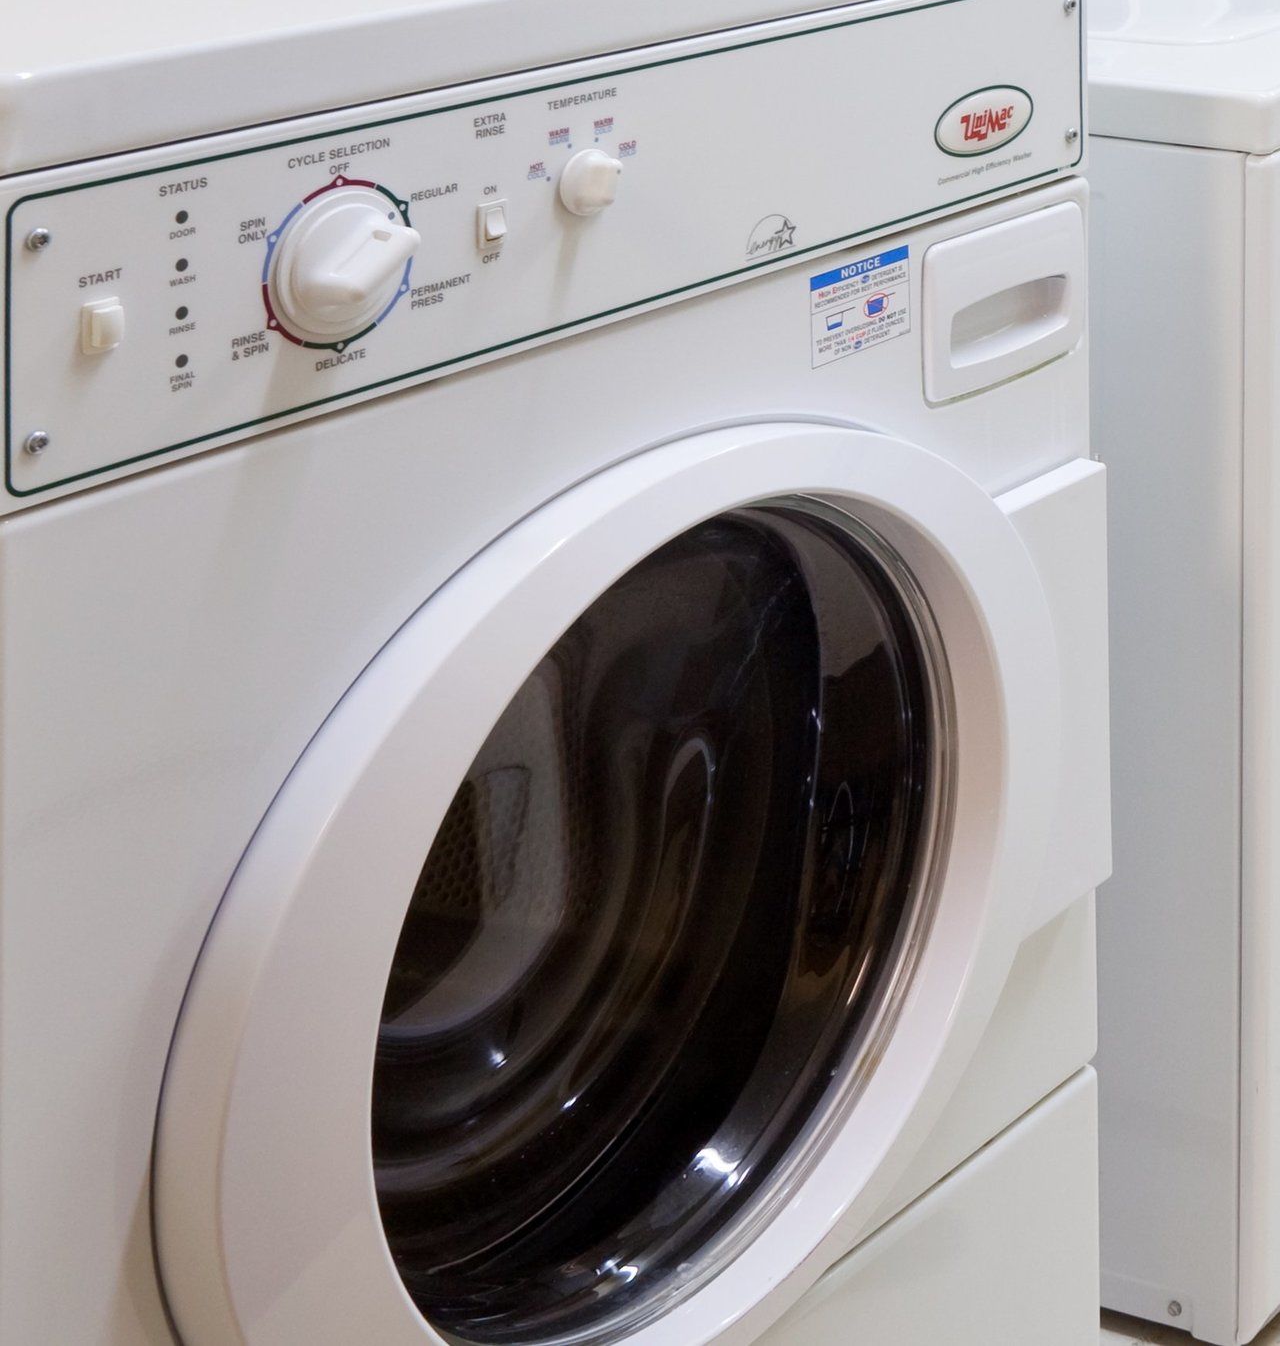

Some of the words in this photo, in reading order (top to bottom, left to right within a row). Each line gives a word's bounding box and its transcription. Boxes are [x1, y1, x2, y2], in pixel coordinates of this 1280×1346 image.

[547, 87, 617, 110] TEMPERATURE
[473, 112, 506, 128] EXTRA
[961, 105, 1014, 141] UniMac
[476, 124, 505, 139] RINSE
[288, 152, 325, 169] CYCLE
[329, 138, 391, 159] SELECTION
[329, 162, 350, 175] OFF
[938, 170, 970, 185] Commercial
[972, 165, 984, 175] High
[986, 158, 1011, 170] Efficiency
[159, 177, 208, 197] STATUS
[411, 183, 458, 202] REGULAR
[484, 185, 497, 195] ON
[240, 217, 266, 231] SPIN
[169, 227, 196, 240] DOOR
[238, 229, 267, 244] ONLY
[482, 252, 500, 264] OFF
[841, 257, 880, 278] NOTICE
[79, 268, 122, 288] START
[169, 275, 196, 287] WASH
[411, 274, 471, 298] PERMANENT
[411, 293, 444, 310] PRESS
[169, 322, 195, 336] RINSE
[232, 331, 266, 349] RINSE
[232, 351, 240, 361] &
[243, 342, 269, 358] SPIN
[315, 348, 366, 372] DELICATE
[170, 371, 195, 384] FINAL
[171, 380, 192, 392] SPIN
